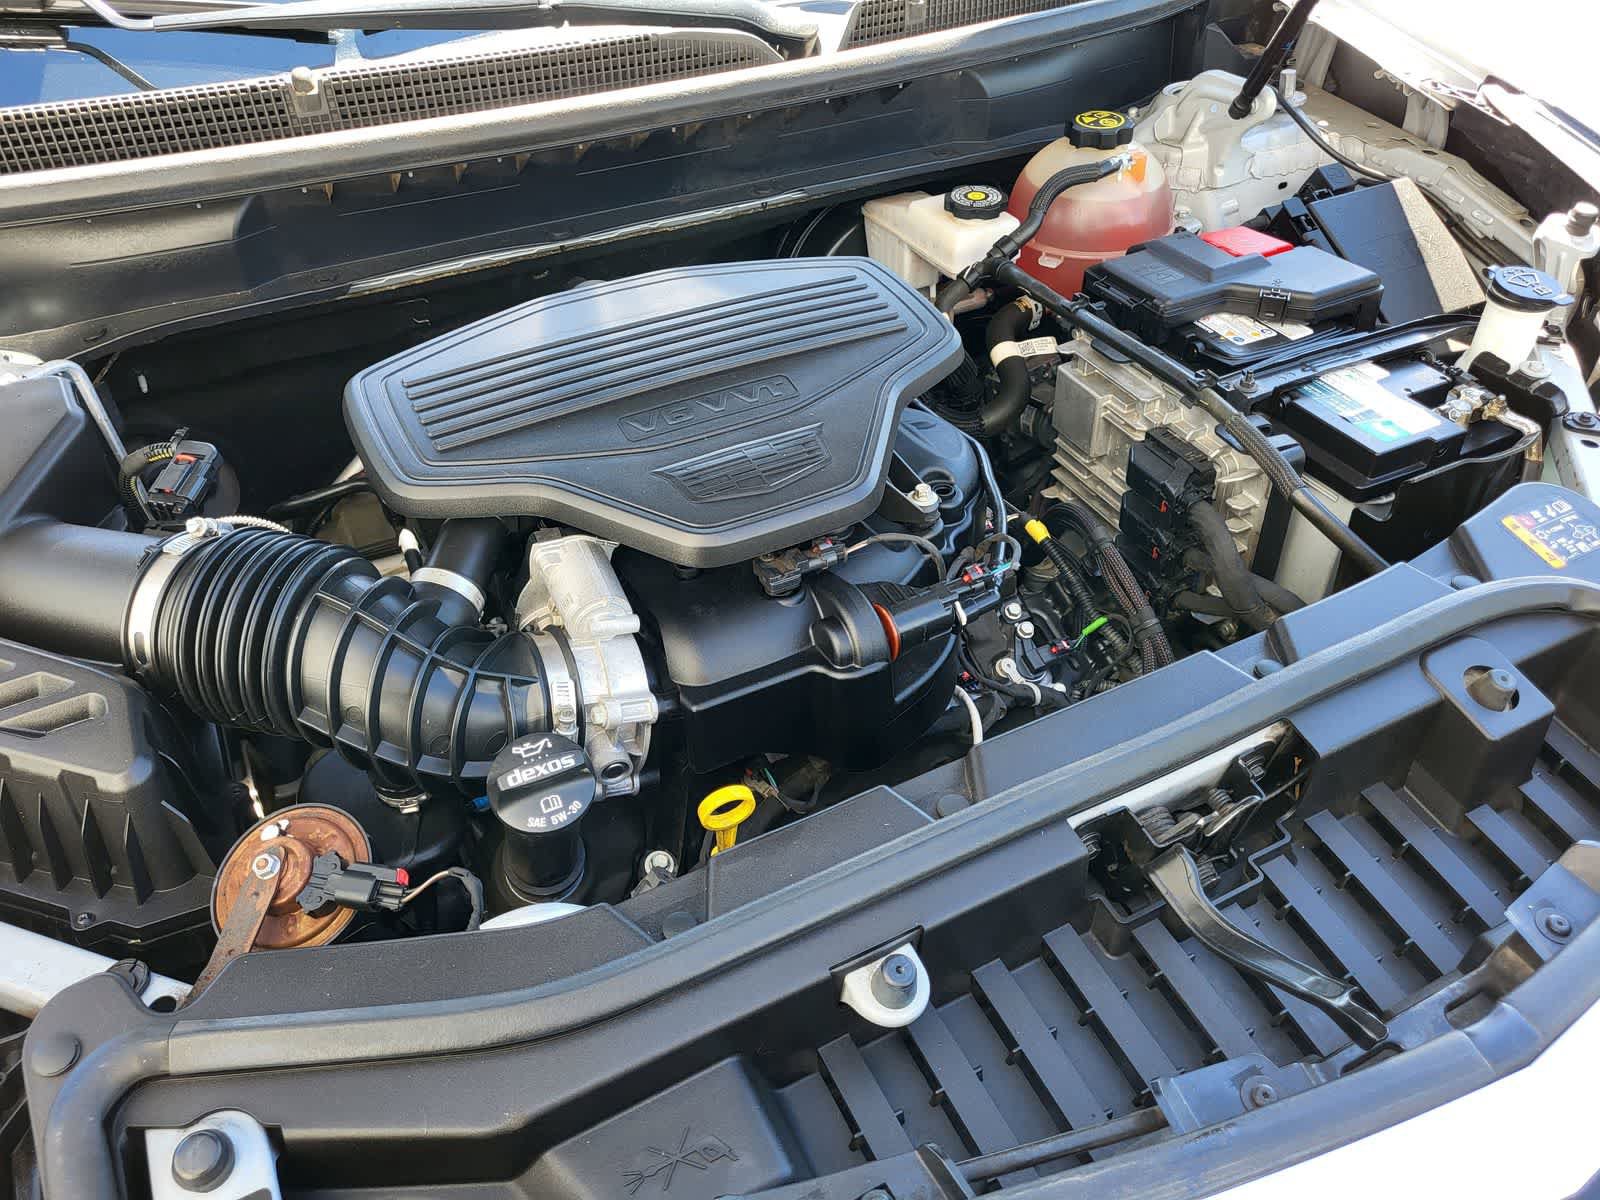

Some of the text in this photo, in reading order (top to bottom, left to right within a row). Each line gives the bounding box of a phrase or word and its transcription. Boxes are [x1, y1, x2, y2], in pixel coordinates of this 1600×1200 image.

[624, 381, 784, 433] V6 VVT
[506, 754, 576, 787] dexos
[527, 800, 583, 828] SAE 5W-30
